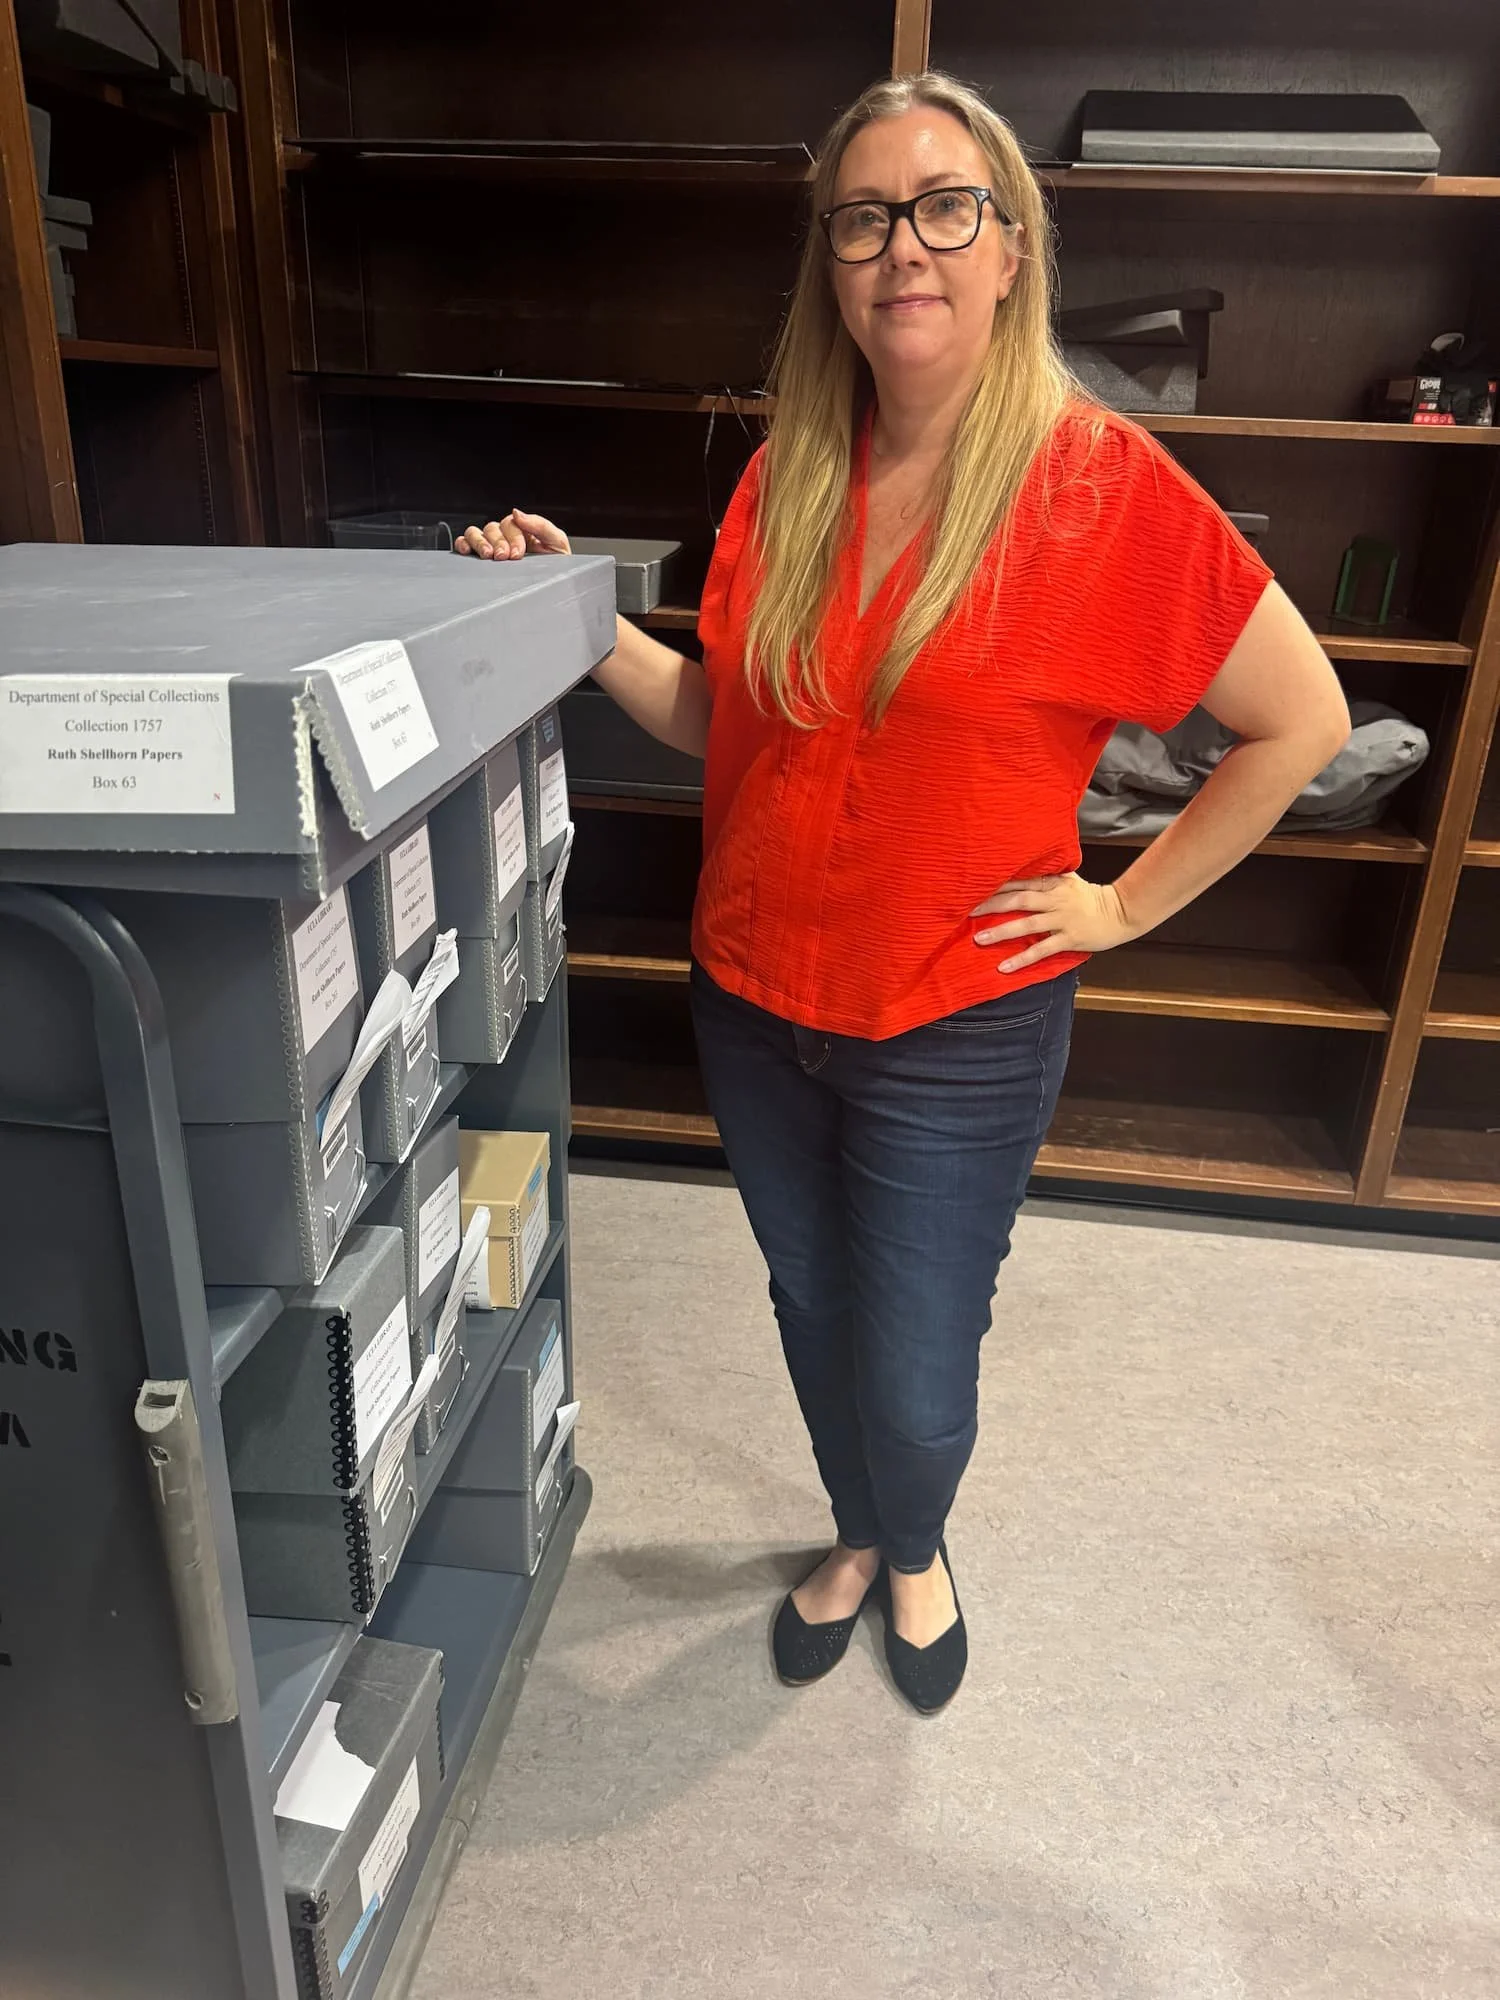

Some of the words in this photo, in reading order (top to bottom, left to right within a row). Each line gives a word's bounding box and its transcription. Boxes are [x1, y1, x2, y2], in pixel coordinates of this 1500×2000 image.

[9, 691, 80, 706] Department
[84, 690, 97, 702] of
[101, 690, 144, 704] Special
[149, 689, 219, 703] Collections
[65, 720, 128, 732] Collection
[134, 719, 162, 732] 1757
[48, 749, 76, 759] Ruth
[81, 748, 137, 760] Shellhorn
[142, 748, 182, 762] Papers
[93, 776, 117, 788] Box
[122, 776, 136, 788] 63
